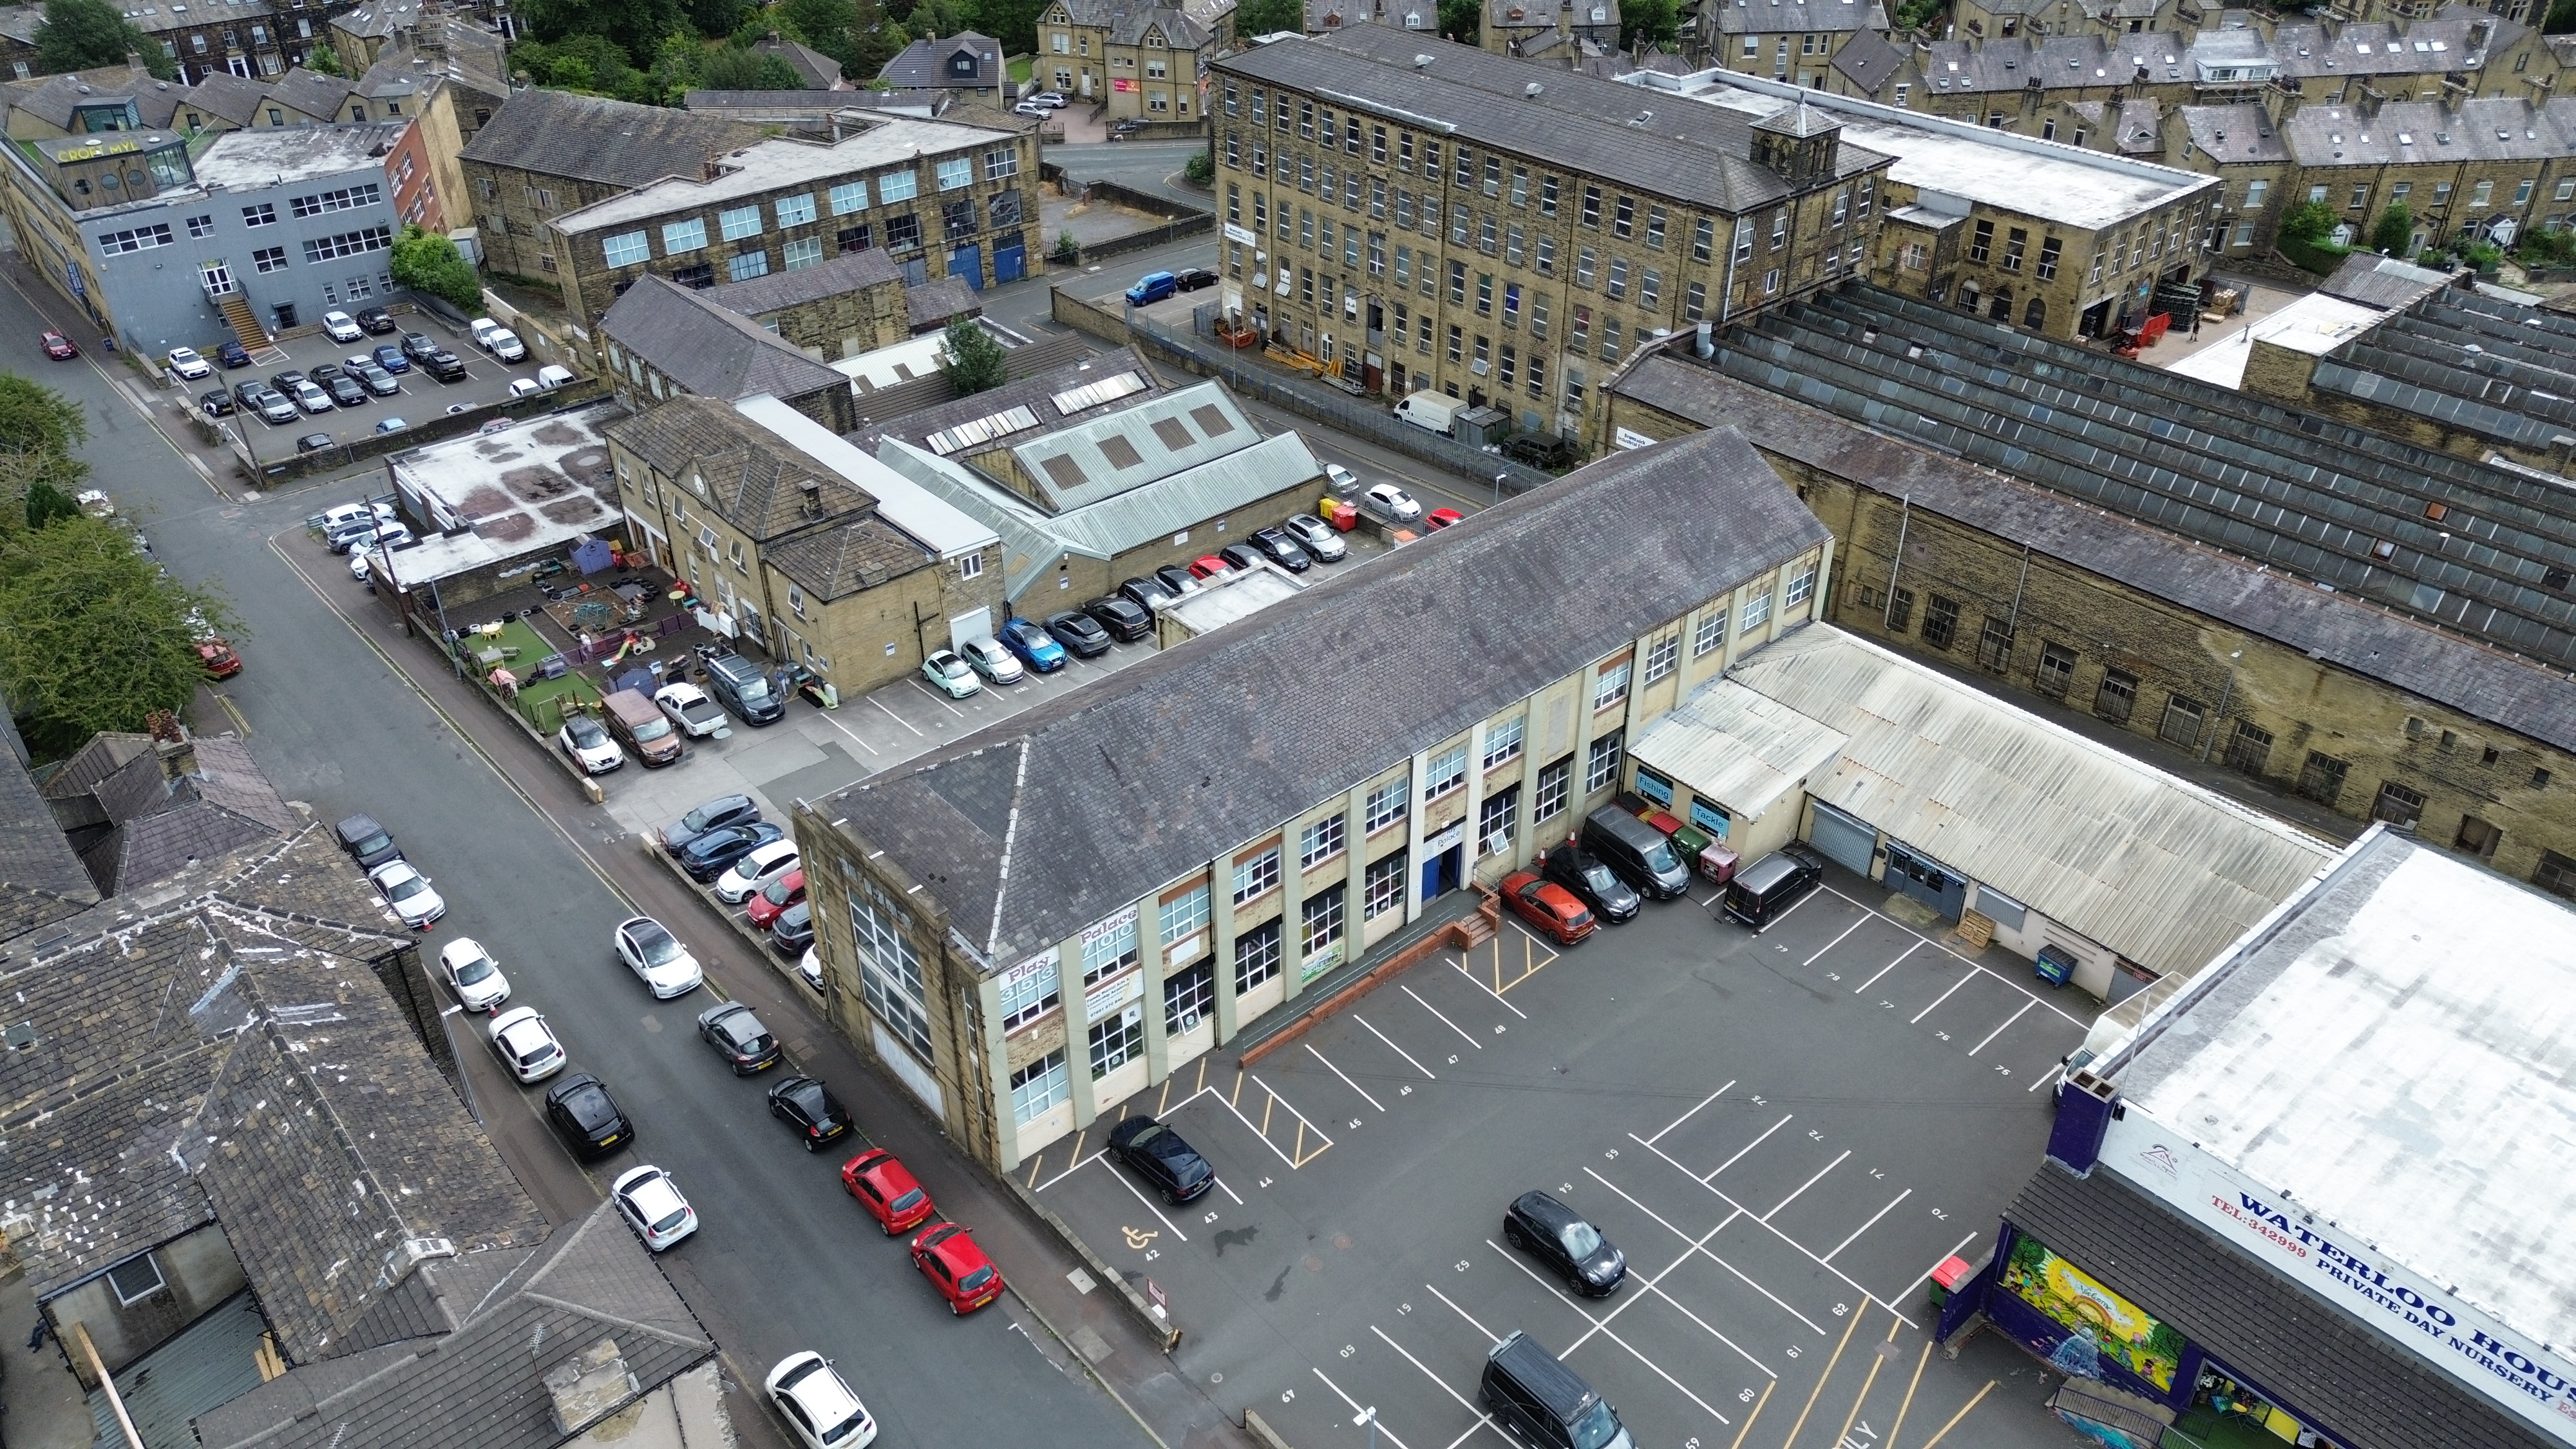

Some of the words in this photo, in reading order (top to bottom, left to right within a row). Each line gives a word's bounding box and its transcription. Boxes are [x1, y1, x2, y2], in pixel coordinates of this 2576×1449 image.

[1639, 776, 1669, 800] Fishing
[1696, 807, 1724, 828] Tackle
[1437, 831, 1460, 847] Palace
[1910, 855, 1938, 875] Jewsons
[1724, 914, 1738, 924] 80
[1008, 956, 1050, 984] Play
[1080, 909, 1137, 945] Palace
[1826, 972, 1840, 981] 78
[1495, 1025, 1506, 1034] 48
[1936, 1031, 1950, 1040] 76
[1448, 1055, 1458, 1064] 47
[1995, 1065, 2011, 1075] 75
[1401, 1086, 1412, 1095] 46
[1752, 1095, 1766, 1106] 73
[1349, 1119, 1361, 1129] 45
[1809, 1130, 1823, 1141] 72
[1605, 1149, 1618, 1159] 55
[1870, 1168, 1884, 1179] 71
[1260, 1177, 1273, 1188] 44
[1559, 1183, 1572, 1193] 54
[1205, 1212, 1218, 1223] 43
[1932, 1208, 1948, 1220] 70
[1146, 1250, 1160, 1261] 42
[2239, 1191, 2456, 1327] WATERLOO
[1455, 1260, 1469, 1271] 52
[1397, 1303, 1411, 1315] 51
[1833, 1303, 1848, 1316] 62
[2315, 1258, 2401, 1315] PRIVATE
[2403, 1310, 2446, 1339] DAY
[2447, 1336, 2555, 1403] NURSERY
[1340, 1345, 1355, 1358] 50
[1787, 1345, 1802, 1358] 61
[1739, 1388, 1754, 1402] 60
